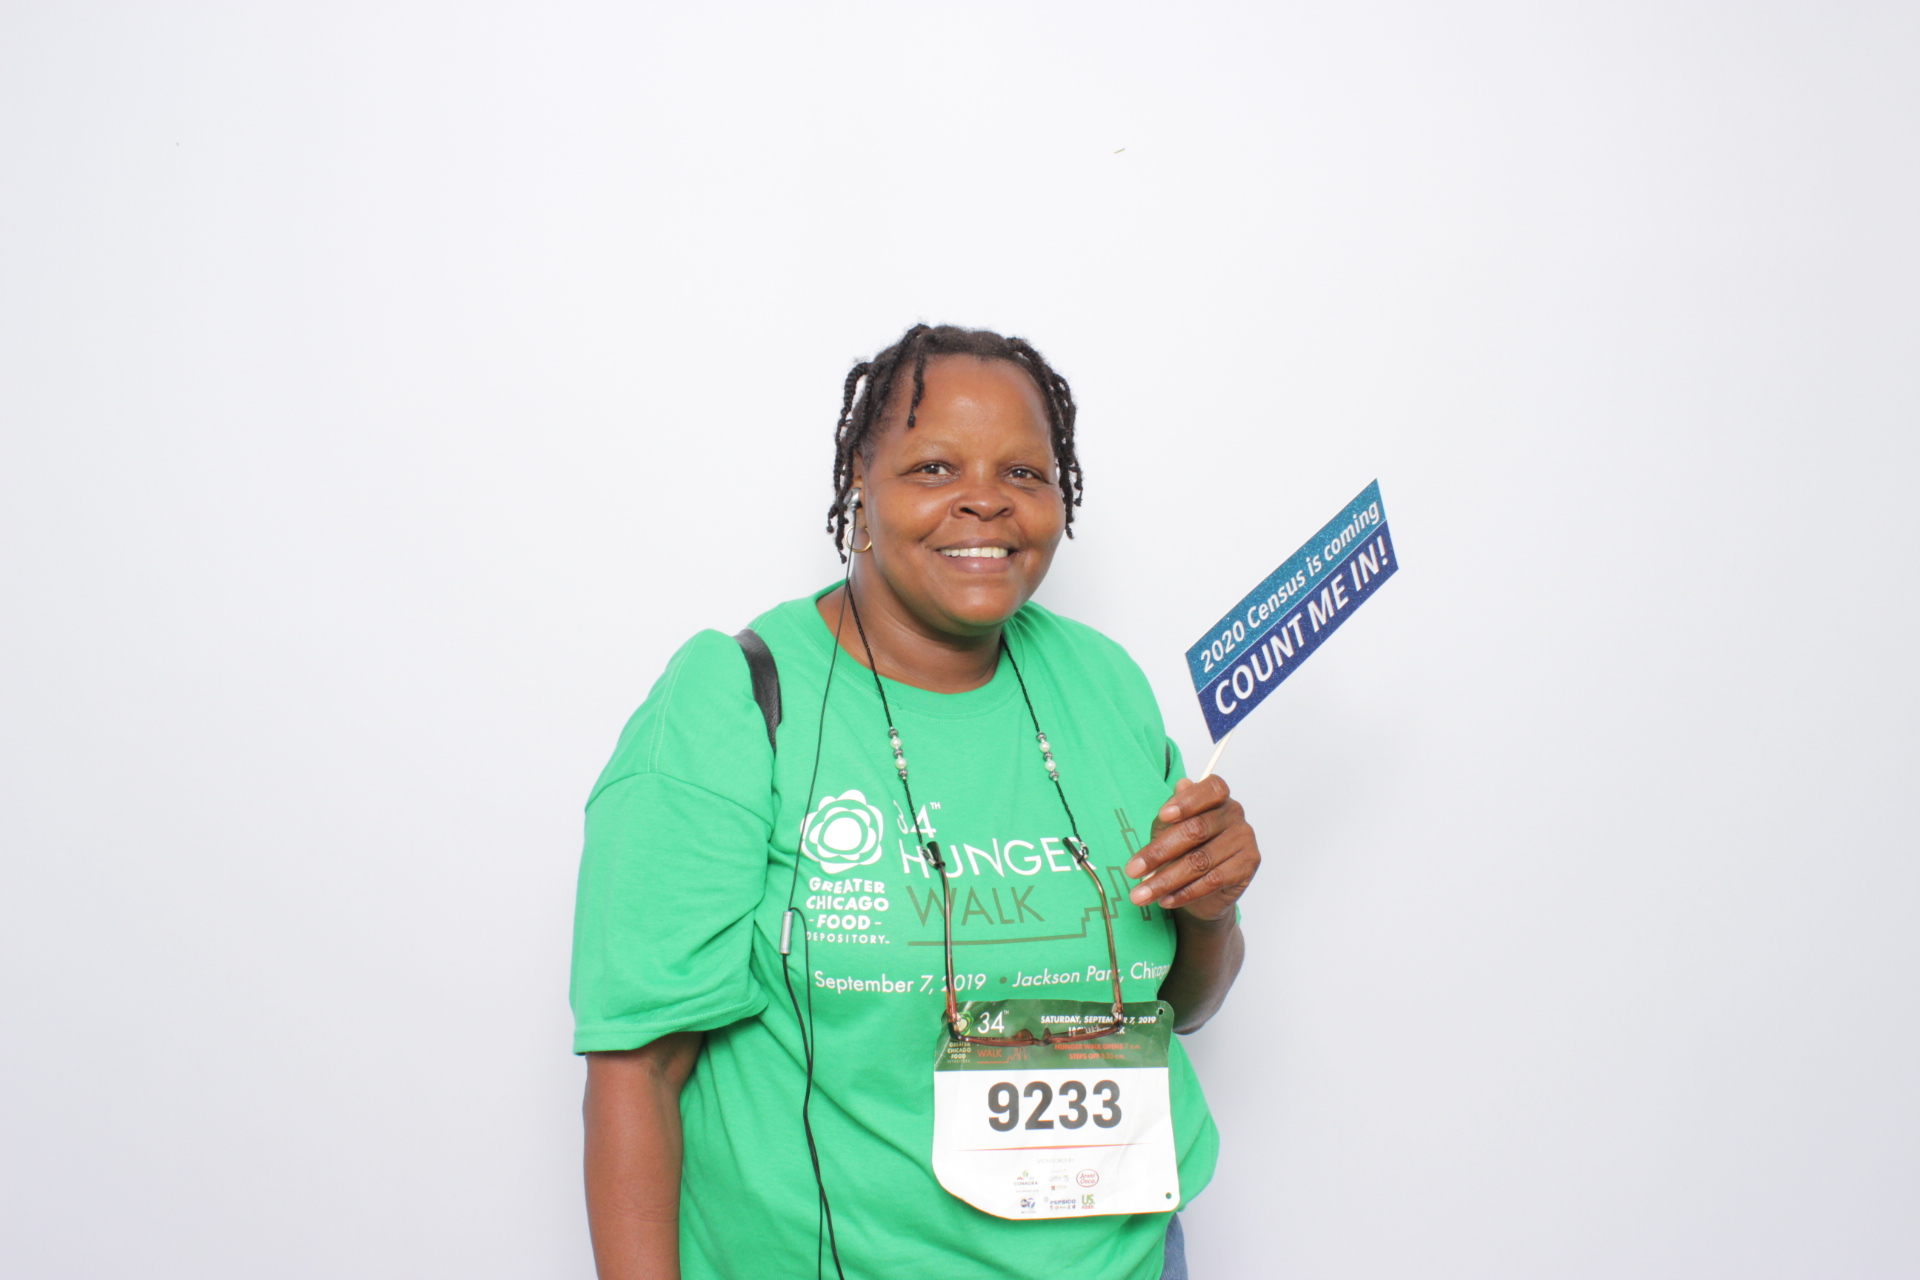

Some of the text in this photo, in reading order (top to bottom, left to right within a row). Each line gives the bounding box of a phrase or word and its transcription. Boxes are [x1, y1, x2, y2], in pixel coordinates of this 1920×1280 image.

[1200, 501, 1380, 673] 2020 Census is coming
[1215, 535, 1389, 715] COUNT ME IN!
[898, 836, 1097, 879] HUNGER
[808, 876, 886, 894] GREATER
[805, 895, 890, 912] CHICAGO
[906, 885, 1046, 928] WALK
[814, 970, 987, 995] September 7, 2019
[1012, 967, 1081, 988] Jackson
[1085, 965, 1125, 983] Par,
[1040, 1015, 1082, 1024] SATURDAY,
[1083, 1015, 1128, 1024] SEPTEMR
[1137, 1016, 1157, 1024] 2019
[977, 1049, 1003, 1058] WALK
[1054, 1043, 1083, 1051] HUNGER
[987, 1079, 1123, 1133] 9233
